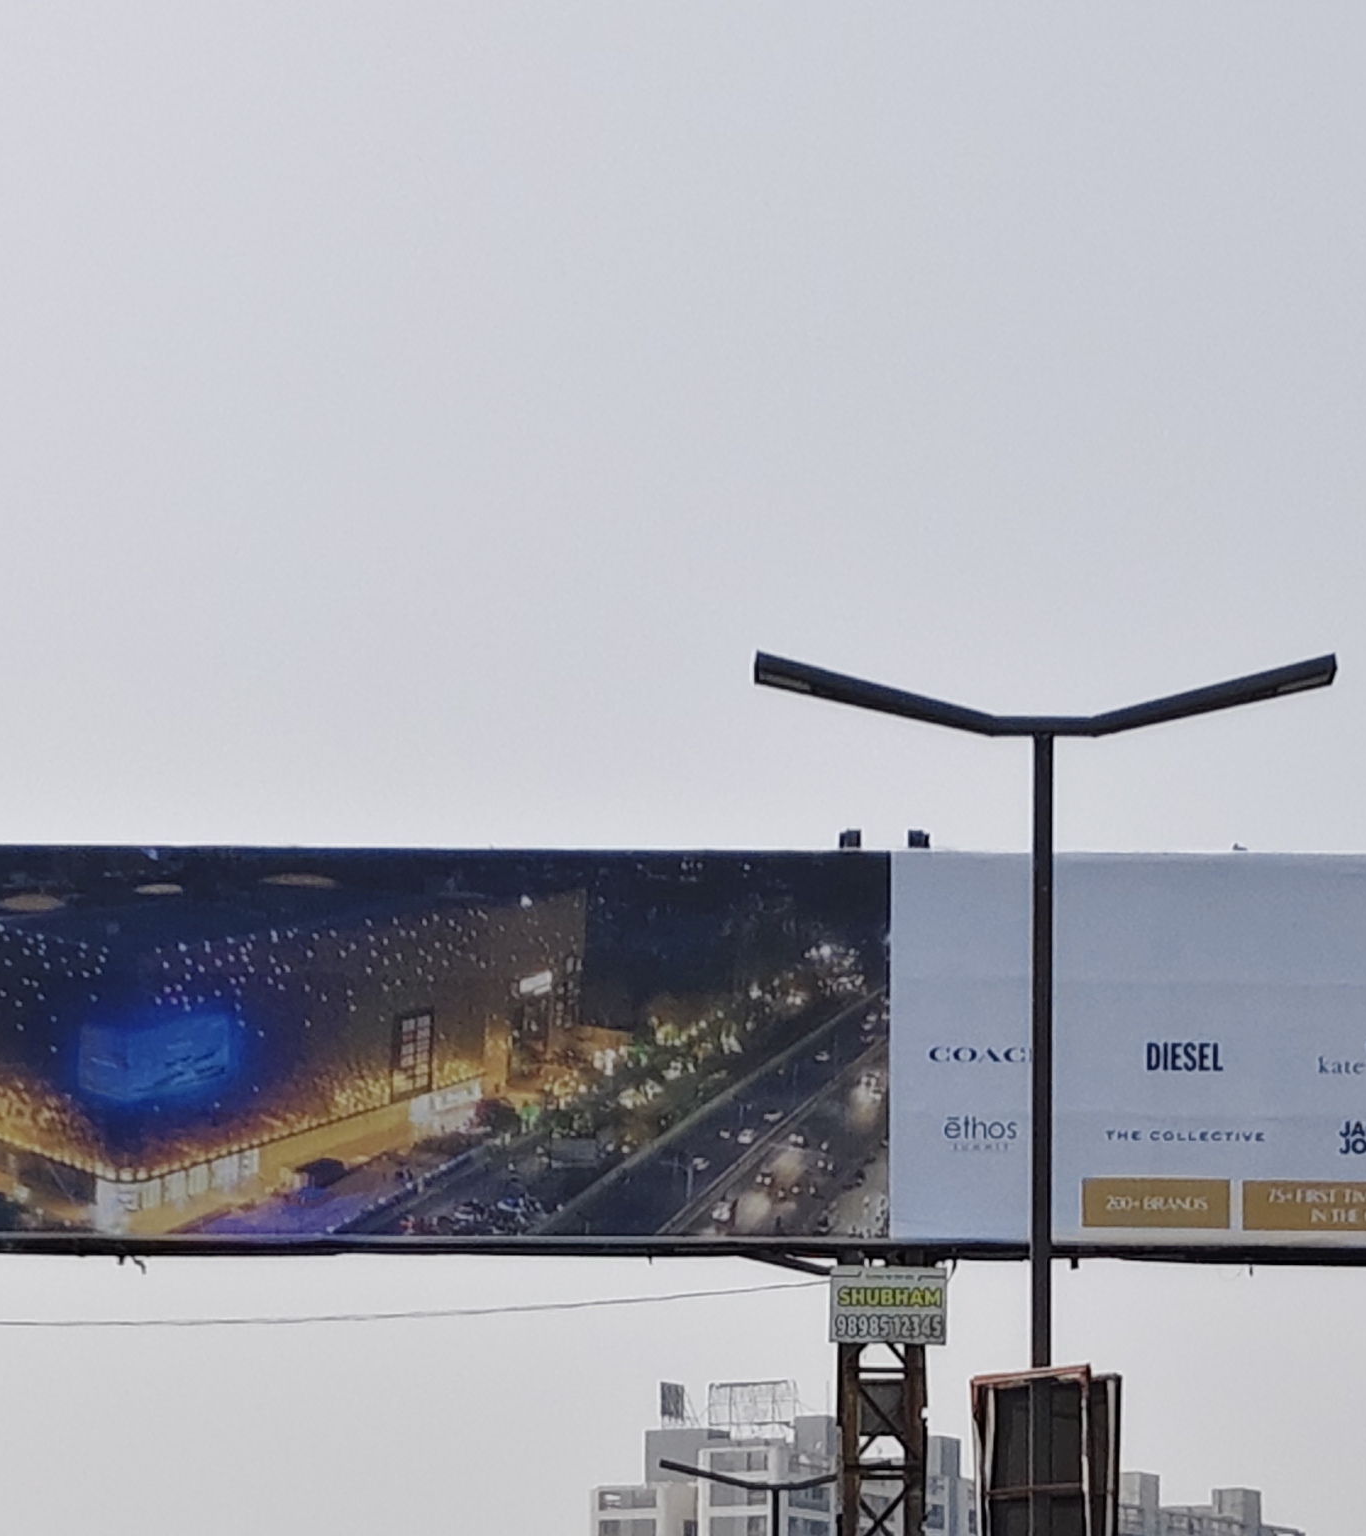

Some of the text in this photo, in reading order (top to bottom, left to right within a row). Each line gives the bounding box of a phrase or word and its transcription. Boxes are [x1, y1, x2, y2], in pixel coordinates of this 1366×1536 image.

[929, 1047, 1032, 1063] COAC
[1146, 1041, 1224, 1072] DIESEL
[1318, 1055, 1365, 1075] kate
[1105, 1130, 1265, 1142] THE COLLECTIVE
[1143, 1196, 1209, 1211] BRANDS
[1295, 1188, 1337, 1204] FIRST
[1310, 1208, 1327, 1223] IN
[1331, 1208, 1358, 1223] THE
[837, 1286, 943, 1308] SHUBHAM
